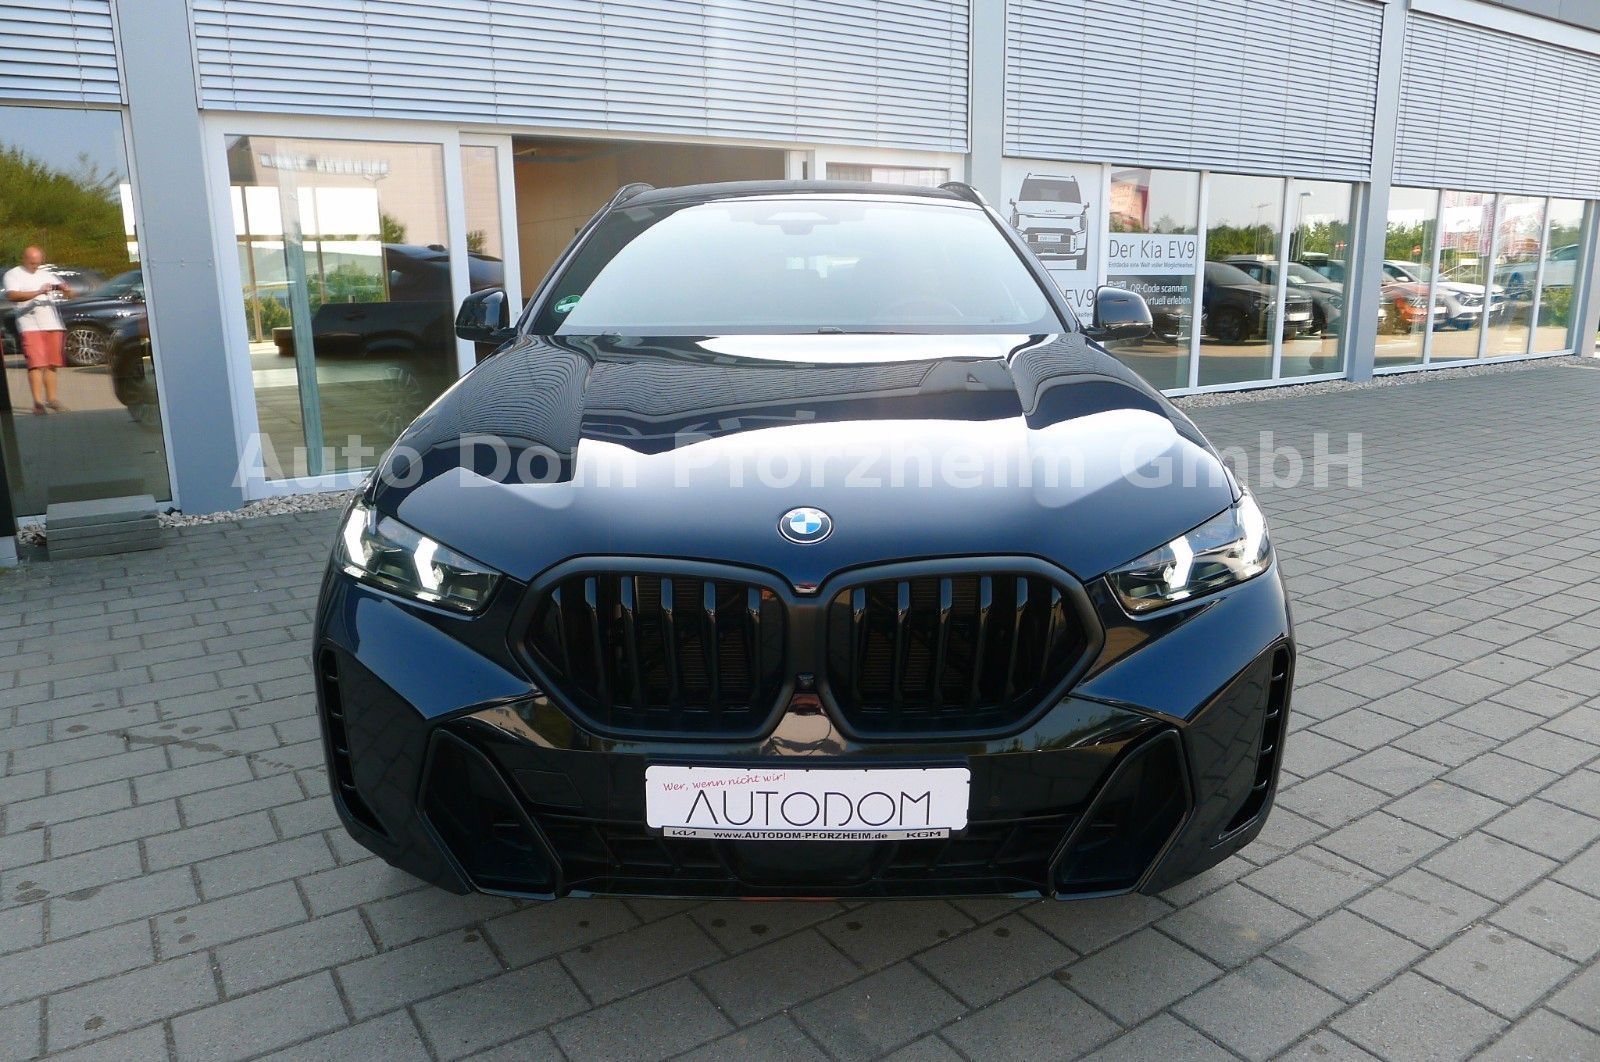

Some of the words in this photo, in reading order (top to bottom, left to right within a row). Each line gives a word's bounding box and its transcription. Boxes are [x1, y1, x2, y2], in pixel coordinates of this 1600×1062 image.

[1109, 240, 1135, 258] Der
[1141, 240, 1162, 258] Kia
[1168, 241, 1195, 258] EV9
[1130, 283, 1160, 293] QR-Code
[1065, 289, 1094, 307] EV9
[663, 782, 689, 791] Wer,
[692, 780, 726, 789] wenn
[728, 774, 760, 786] nicht
[763, 772, 787, 781] wir!
[685, 789, 931, 827] AUTODOM
[713, 831, 888, 840] www.AUTODOM-PFORZHEIM.de
